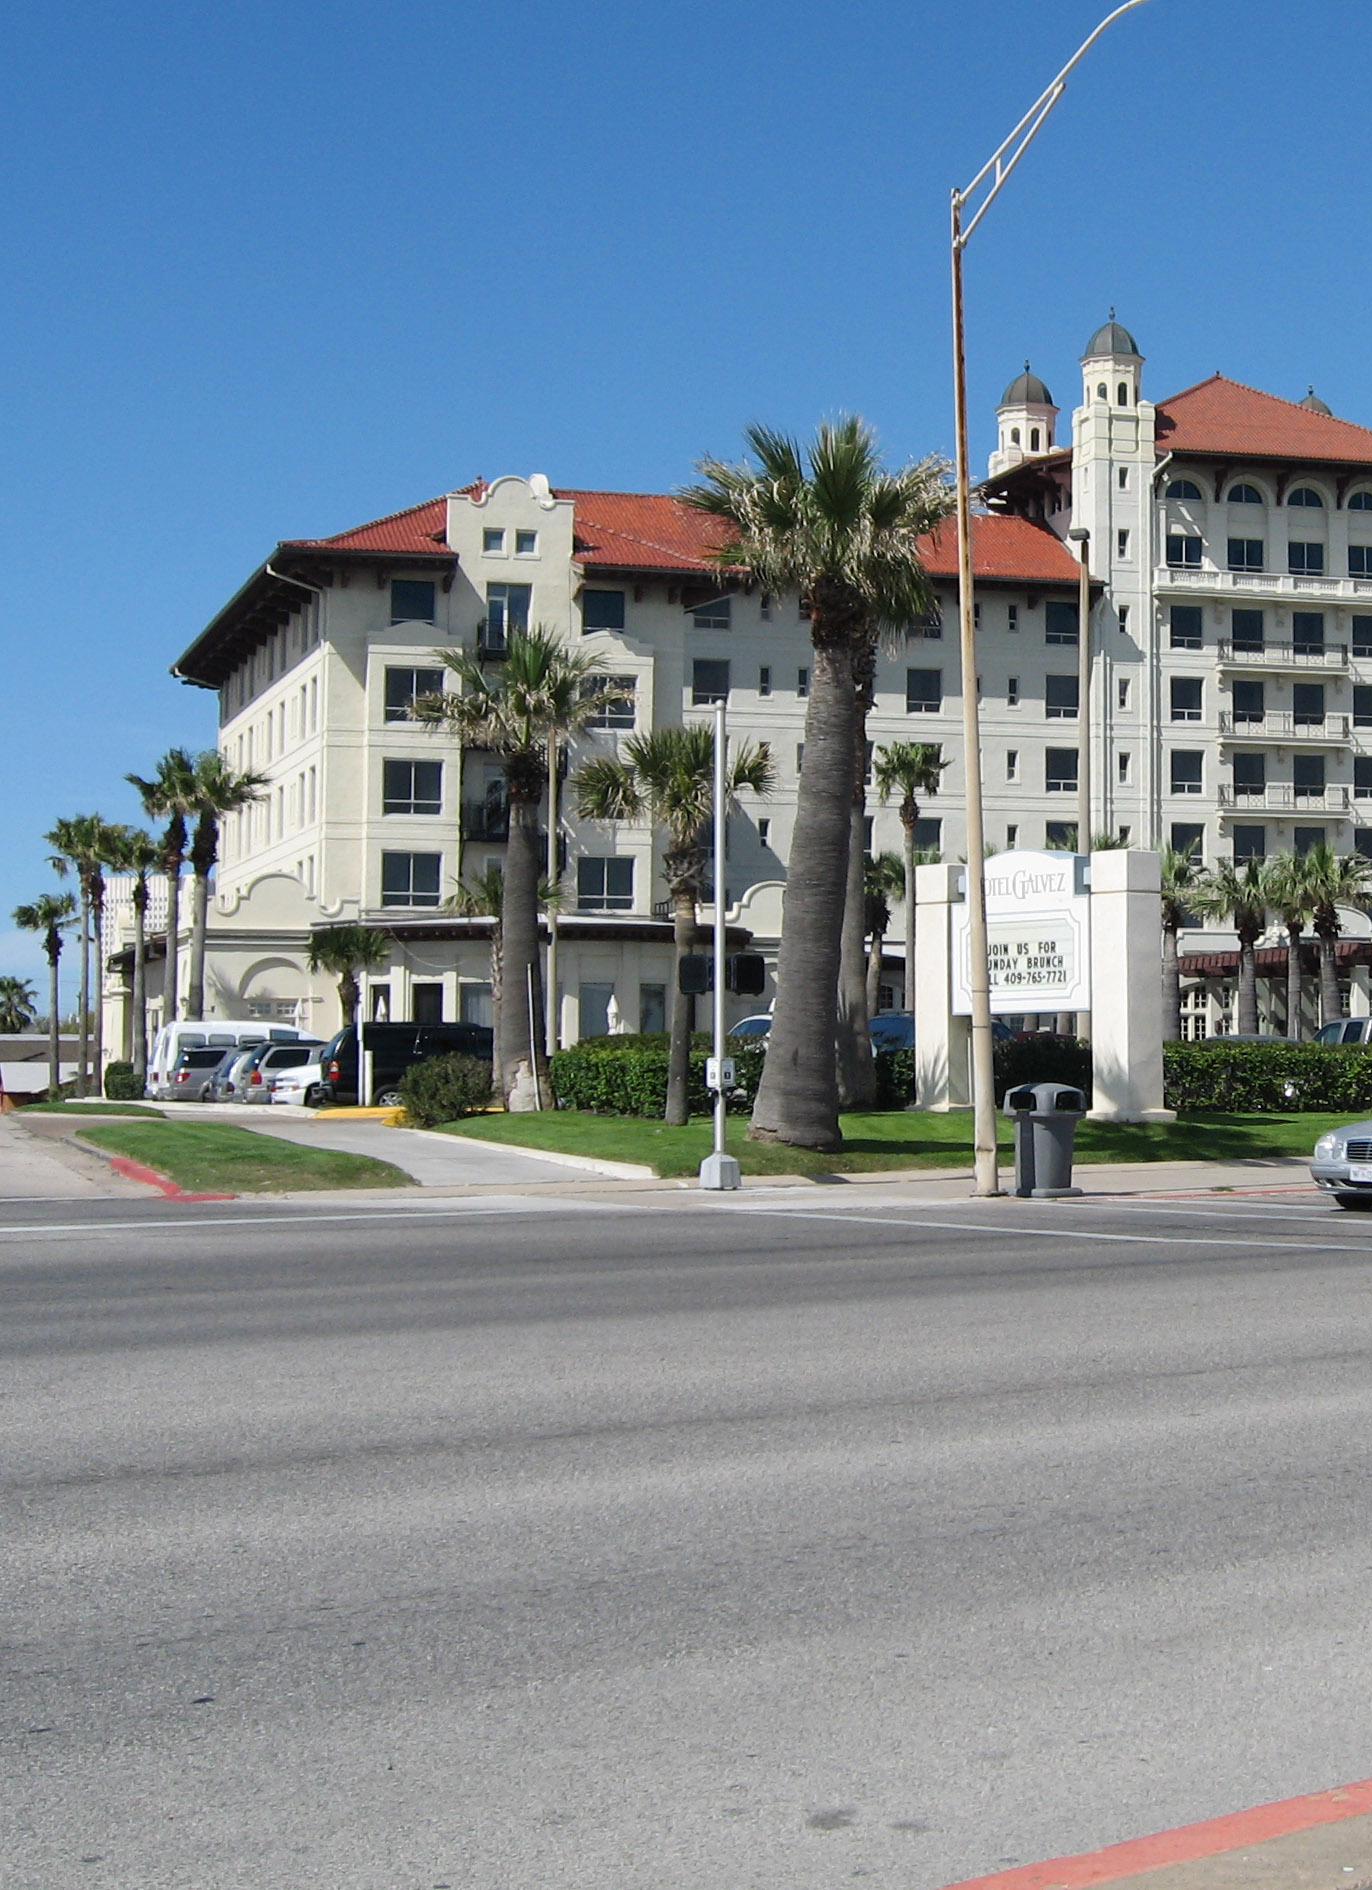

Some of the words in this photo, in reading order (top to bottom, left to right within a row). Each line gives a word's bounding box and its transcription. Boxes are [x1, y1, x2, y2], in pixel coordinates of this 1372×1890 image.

[985, 876, 1012, 897] OTEL
[986, 943, 1009, 957] JOIN
[1016, 942, 1030, 955] US
[1038, 941, 1057, 954] FOR
[987, 957, 1019, 971] UNDAY
[1027, 955, 1064, 970] BRUNCH
[1003, 970, 1067, 985] 409-765-7721
